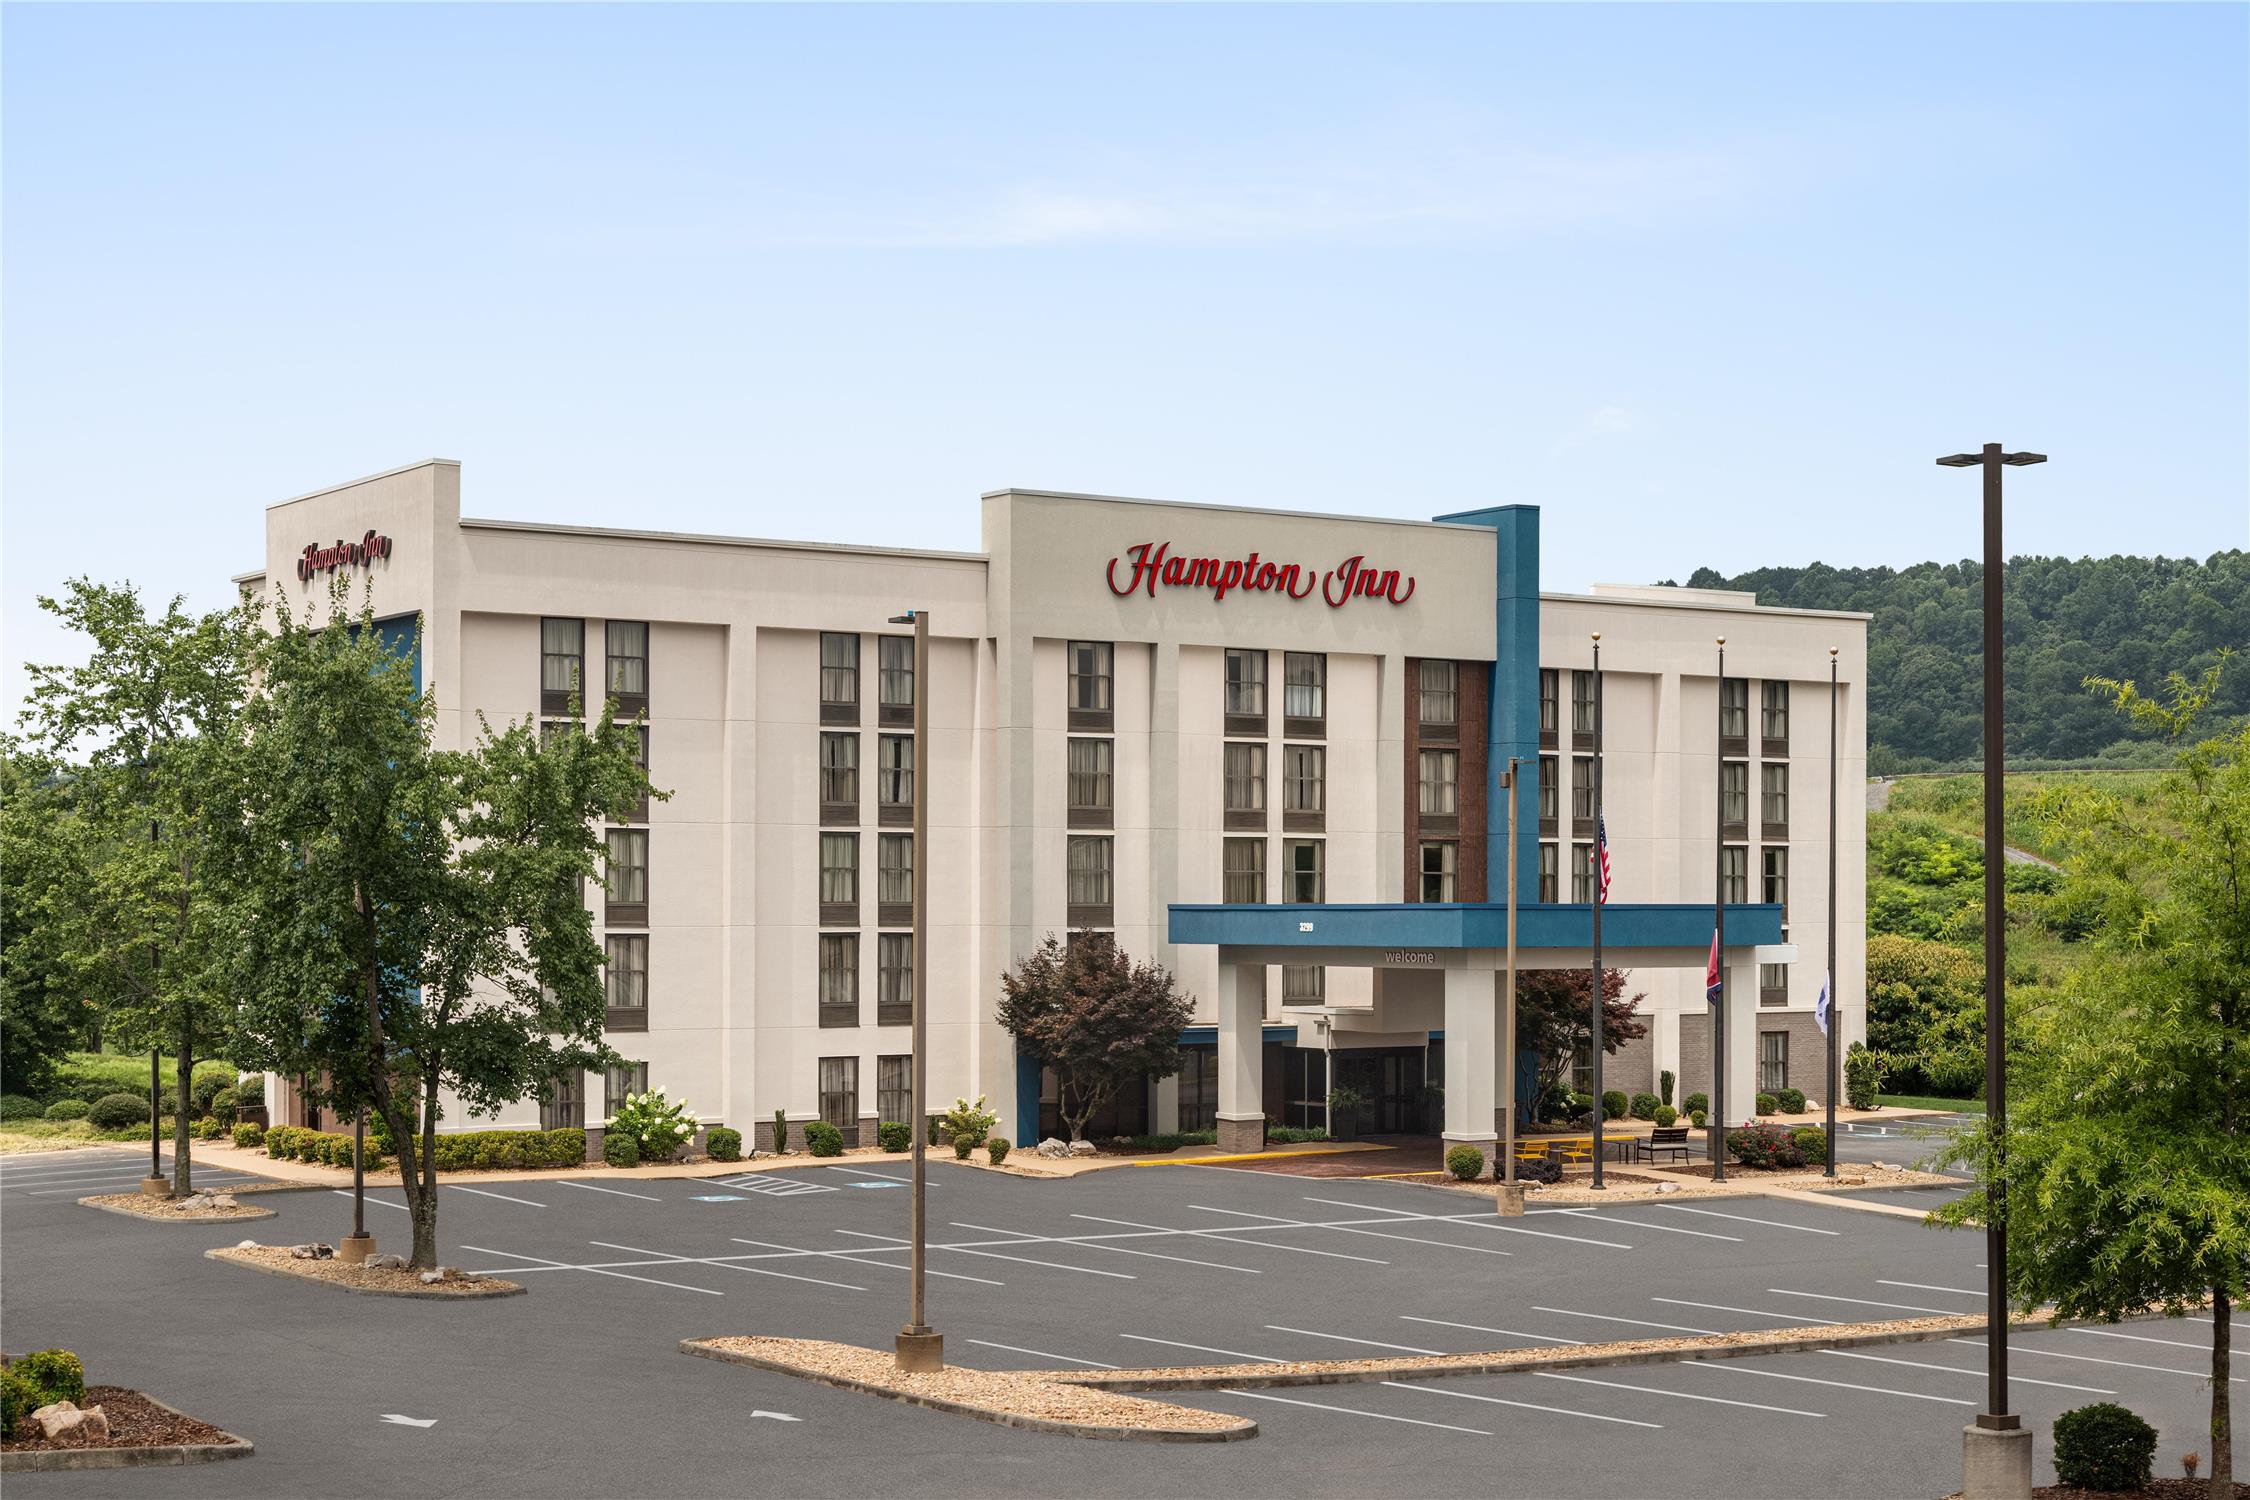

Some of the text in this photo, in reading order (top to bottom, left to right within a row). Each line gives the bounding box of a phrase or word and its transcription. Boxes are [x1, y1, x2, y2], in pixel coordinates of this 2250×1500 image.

[297, 529, 393, 581] Hampton Inn
[1106, 541, 1416, 608] Hampton Inn
[1385, 949, 1435, 964] welcome
